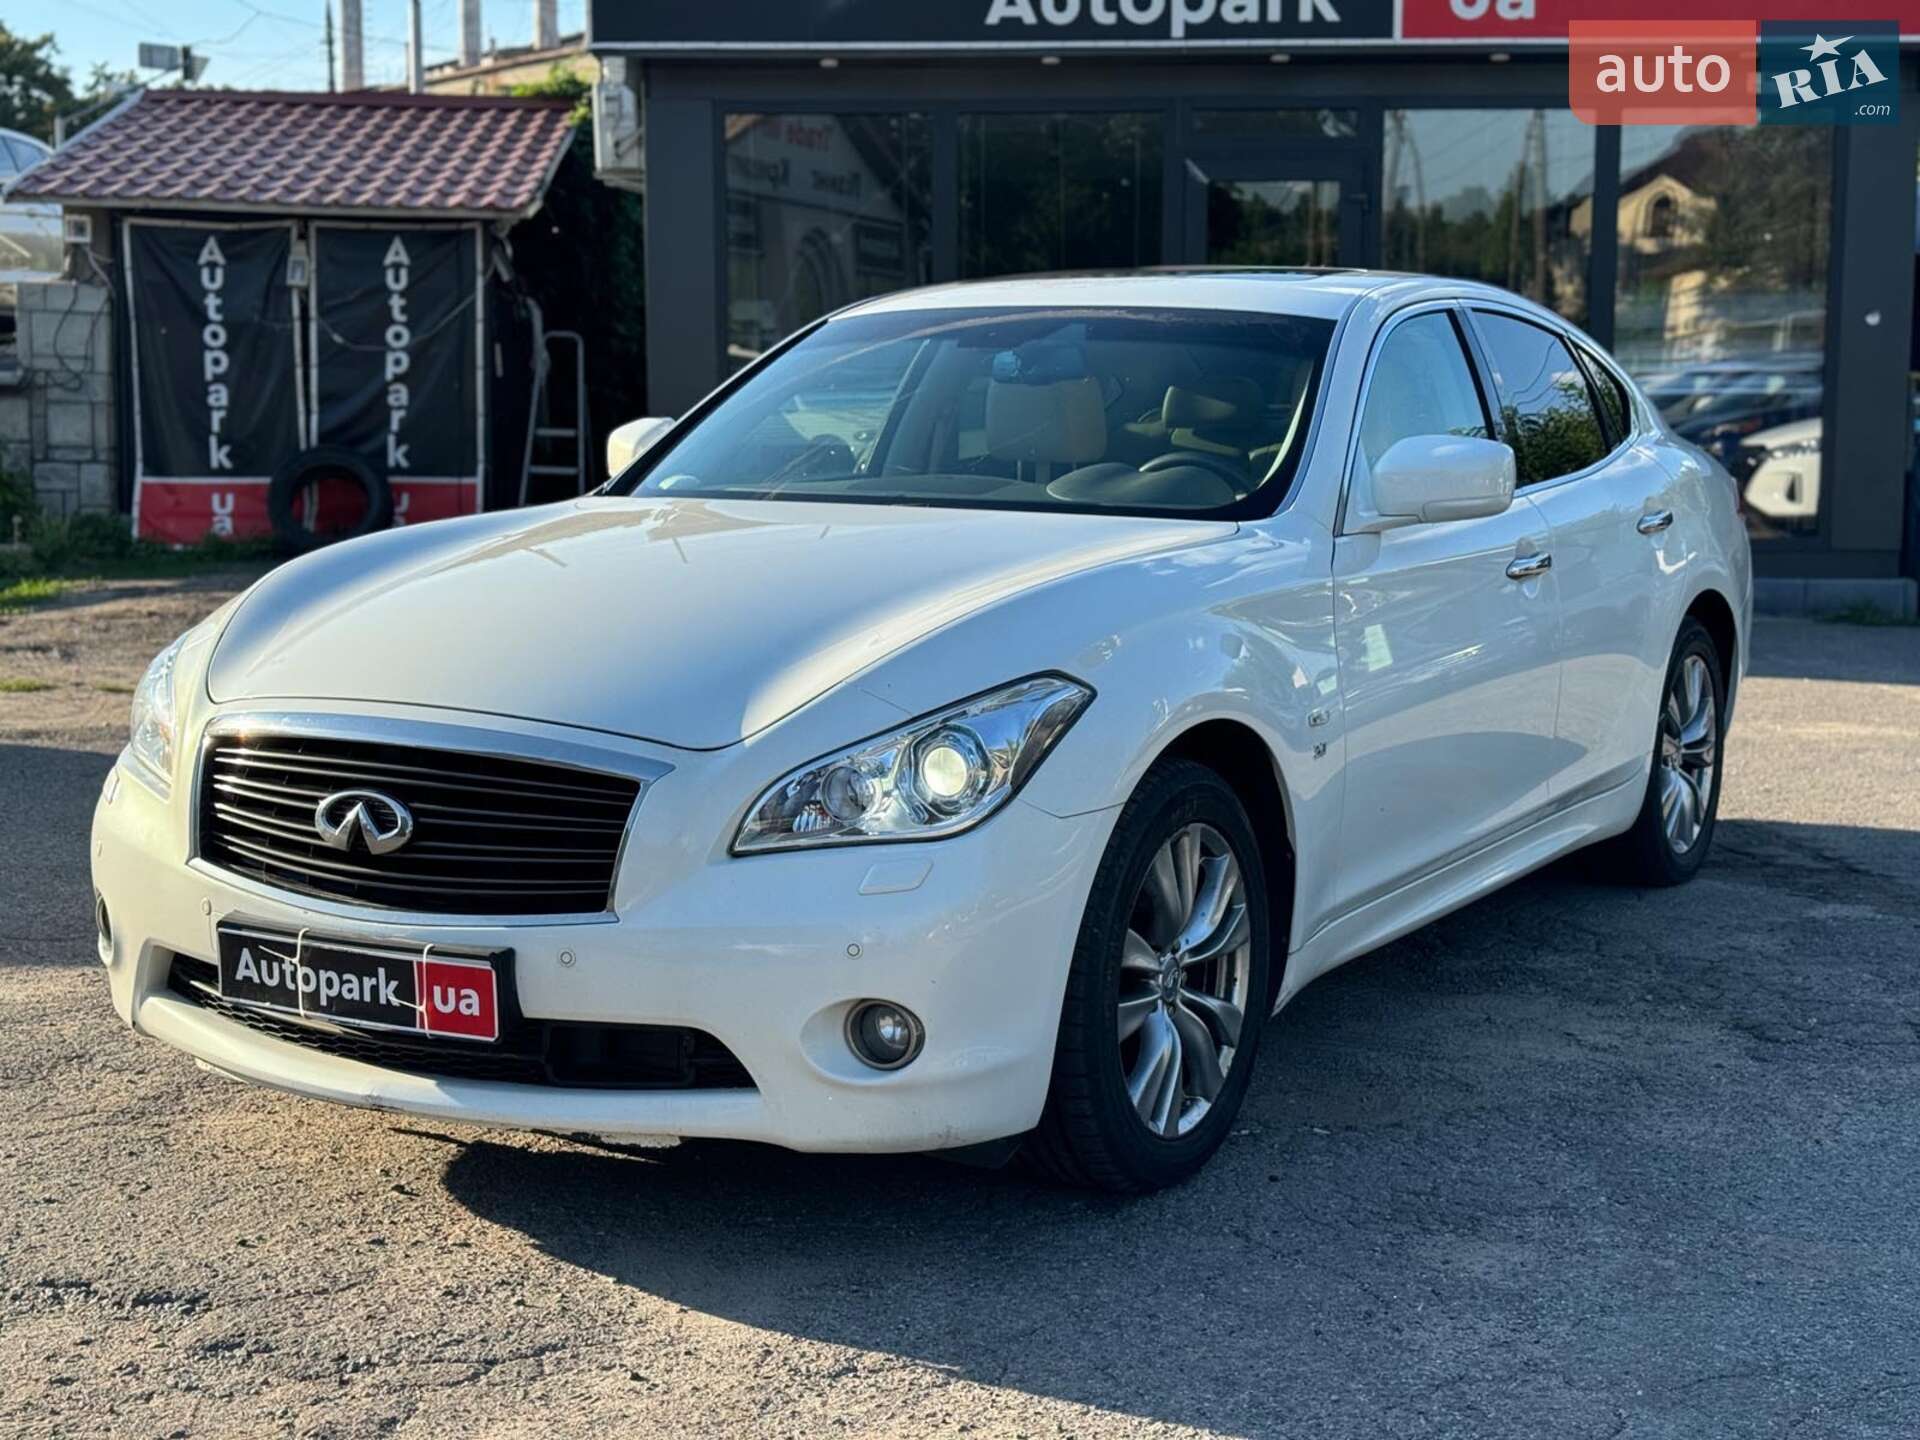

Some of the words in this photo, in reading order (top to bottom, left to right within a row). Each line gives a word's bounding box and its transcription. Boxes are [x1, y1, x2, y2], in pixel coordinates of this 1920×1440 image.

[198, 236, 233, 469] Autopark
[383, 236, 411, 468] Autopark
[211, 493, 234, 536] ua
[235, 947, 400, 1007] Autopark
[432, 984, 481, 1016] ua
